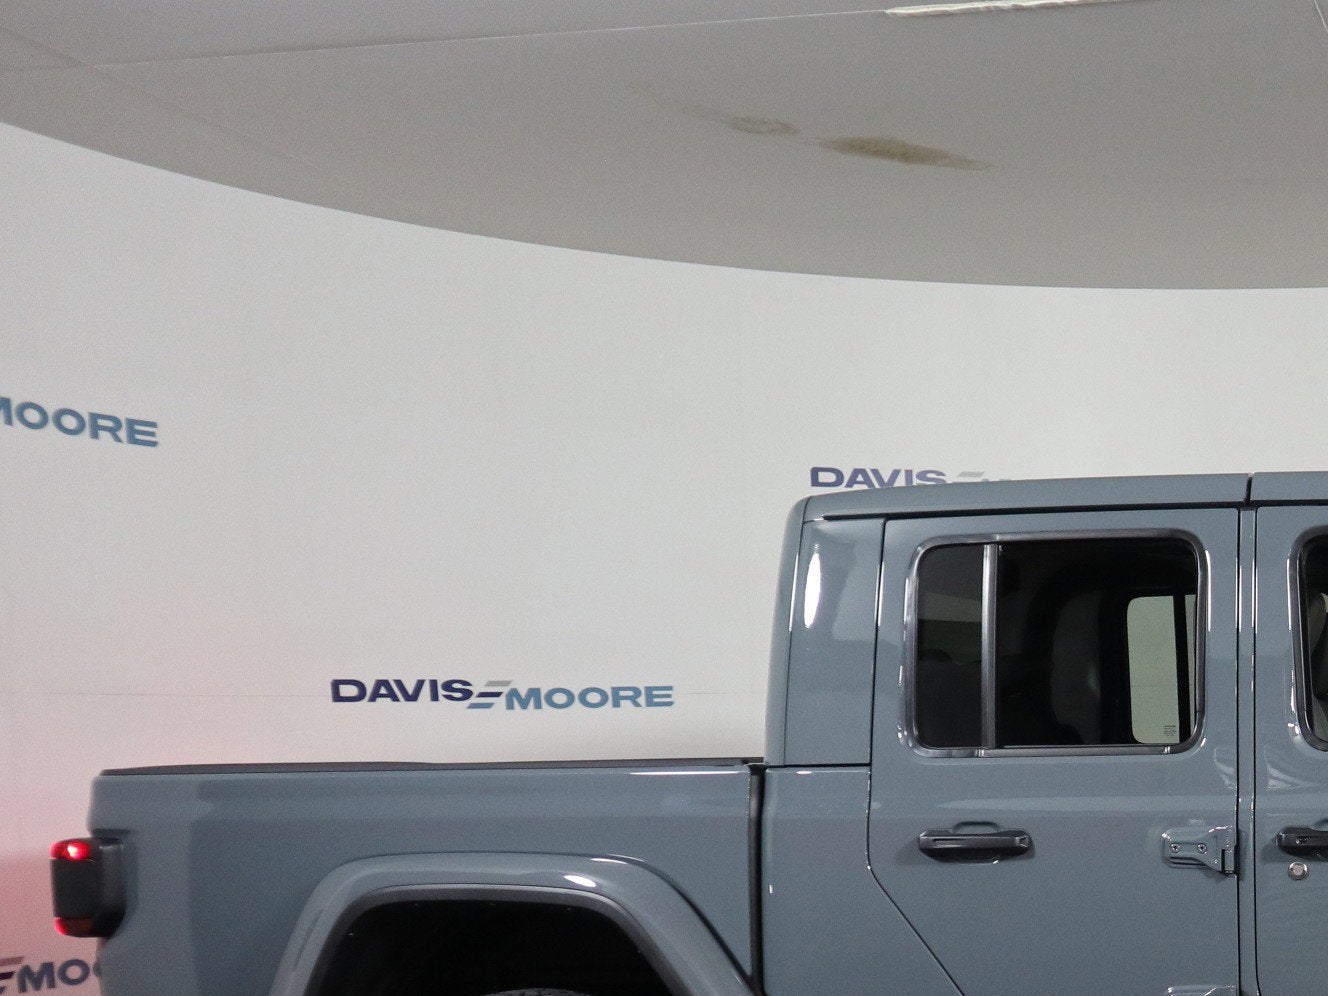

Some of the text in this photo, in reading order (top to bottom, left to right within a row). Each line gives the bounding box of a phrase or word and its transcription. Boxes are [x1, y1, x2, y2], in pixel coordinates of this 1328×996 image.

[810, 467, 947, 488] DAVIS
[331, 679, 674, 710] DAVIS MOORE
